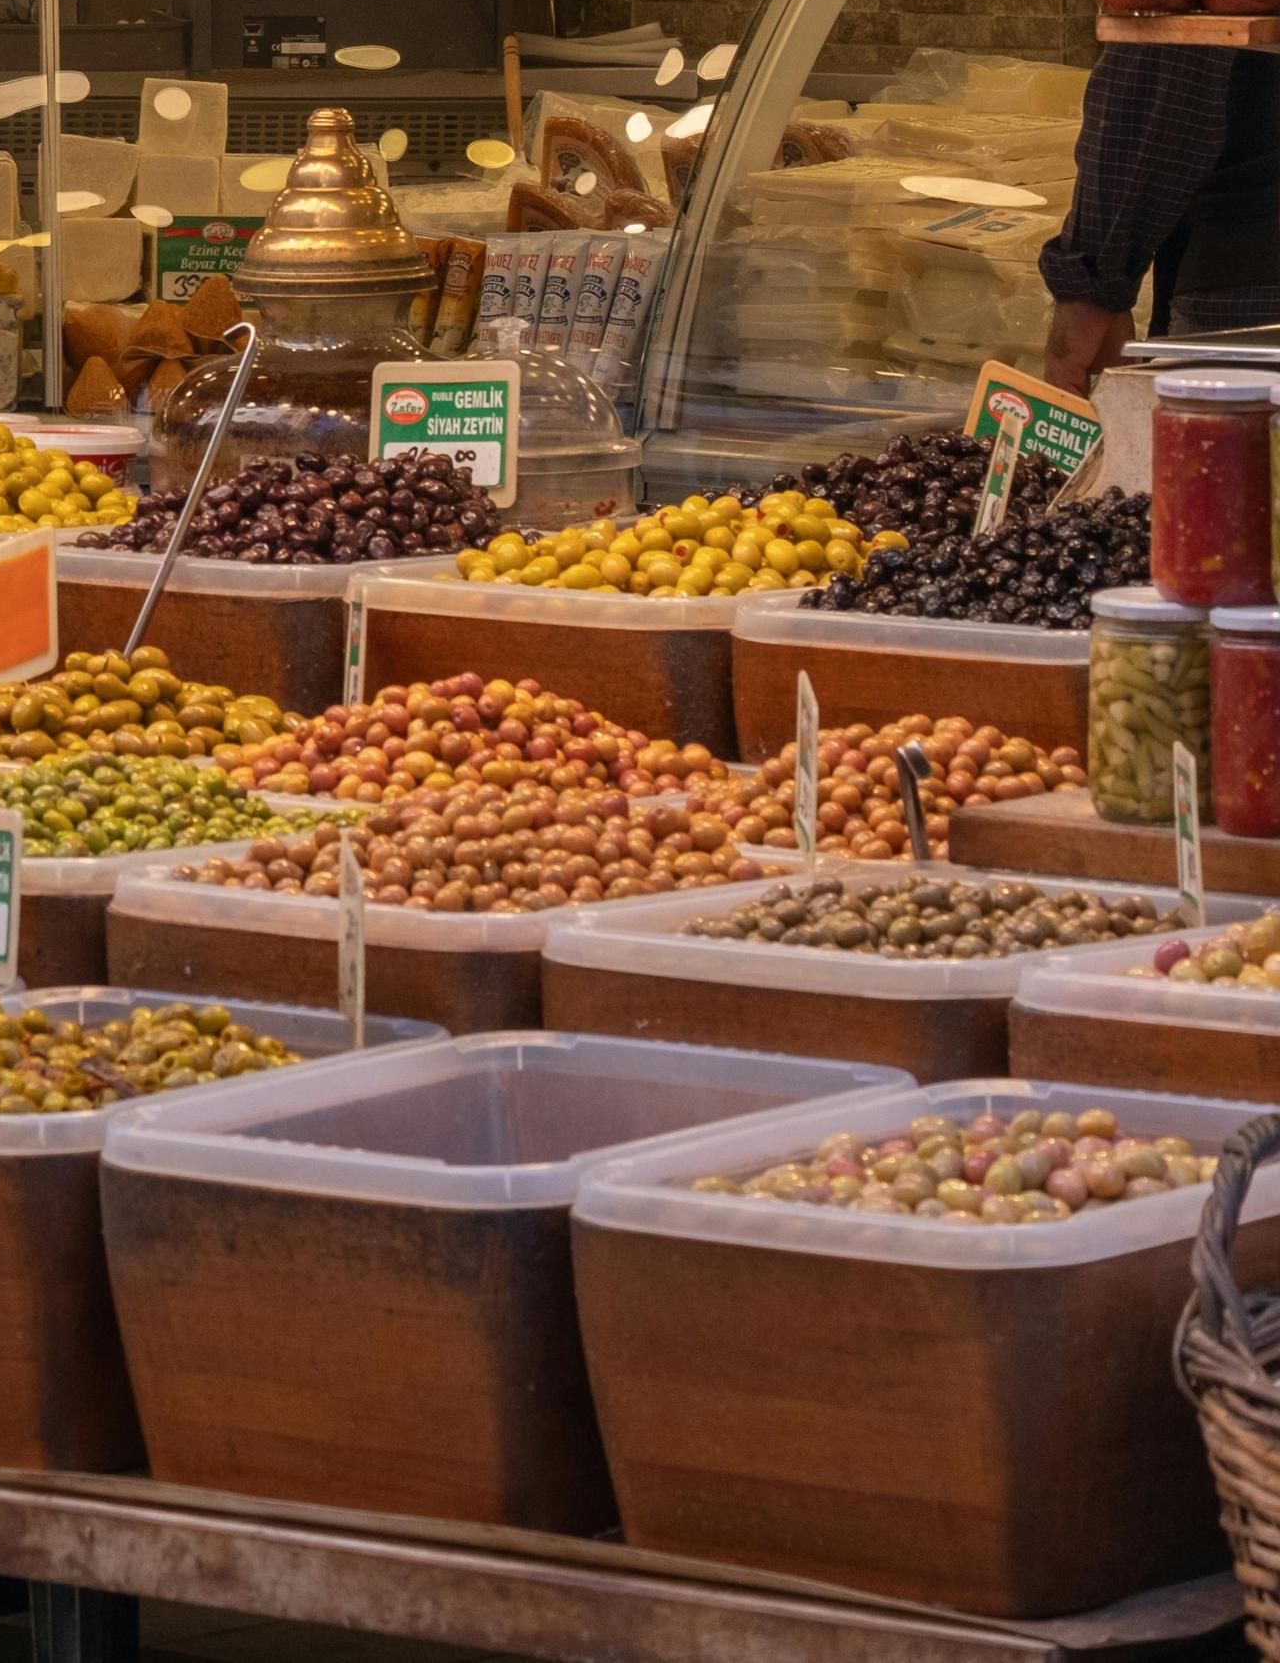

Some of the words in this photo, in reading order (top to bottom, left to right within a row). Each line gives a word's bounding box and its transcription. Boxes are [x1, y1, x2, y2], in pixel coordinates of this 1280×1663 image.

[188, 245, 220, 257] Ezine
[180, 258, 217, 270] Beyaz
[219, 259, 243, 271] Pey
[454, 387, 503, 409] GEMLİK
[427, 414, 461, 436] SİYAH
[463, 413, 504, 435] ZEYTİN
[1049, 406, 1068, 424] İRİ
[1070, 418, 1099, 436] BOY
[1025, 438, 1061, 461] SİYAH
[1034, 420, 1092, 456] GEMLİ
